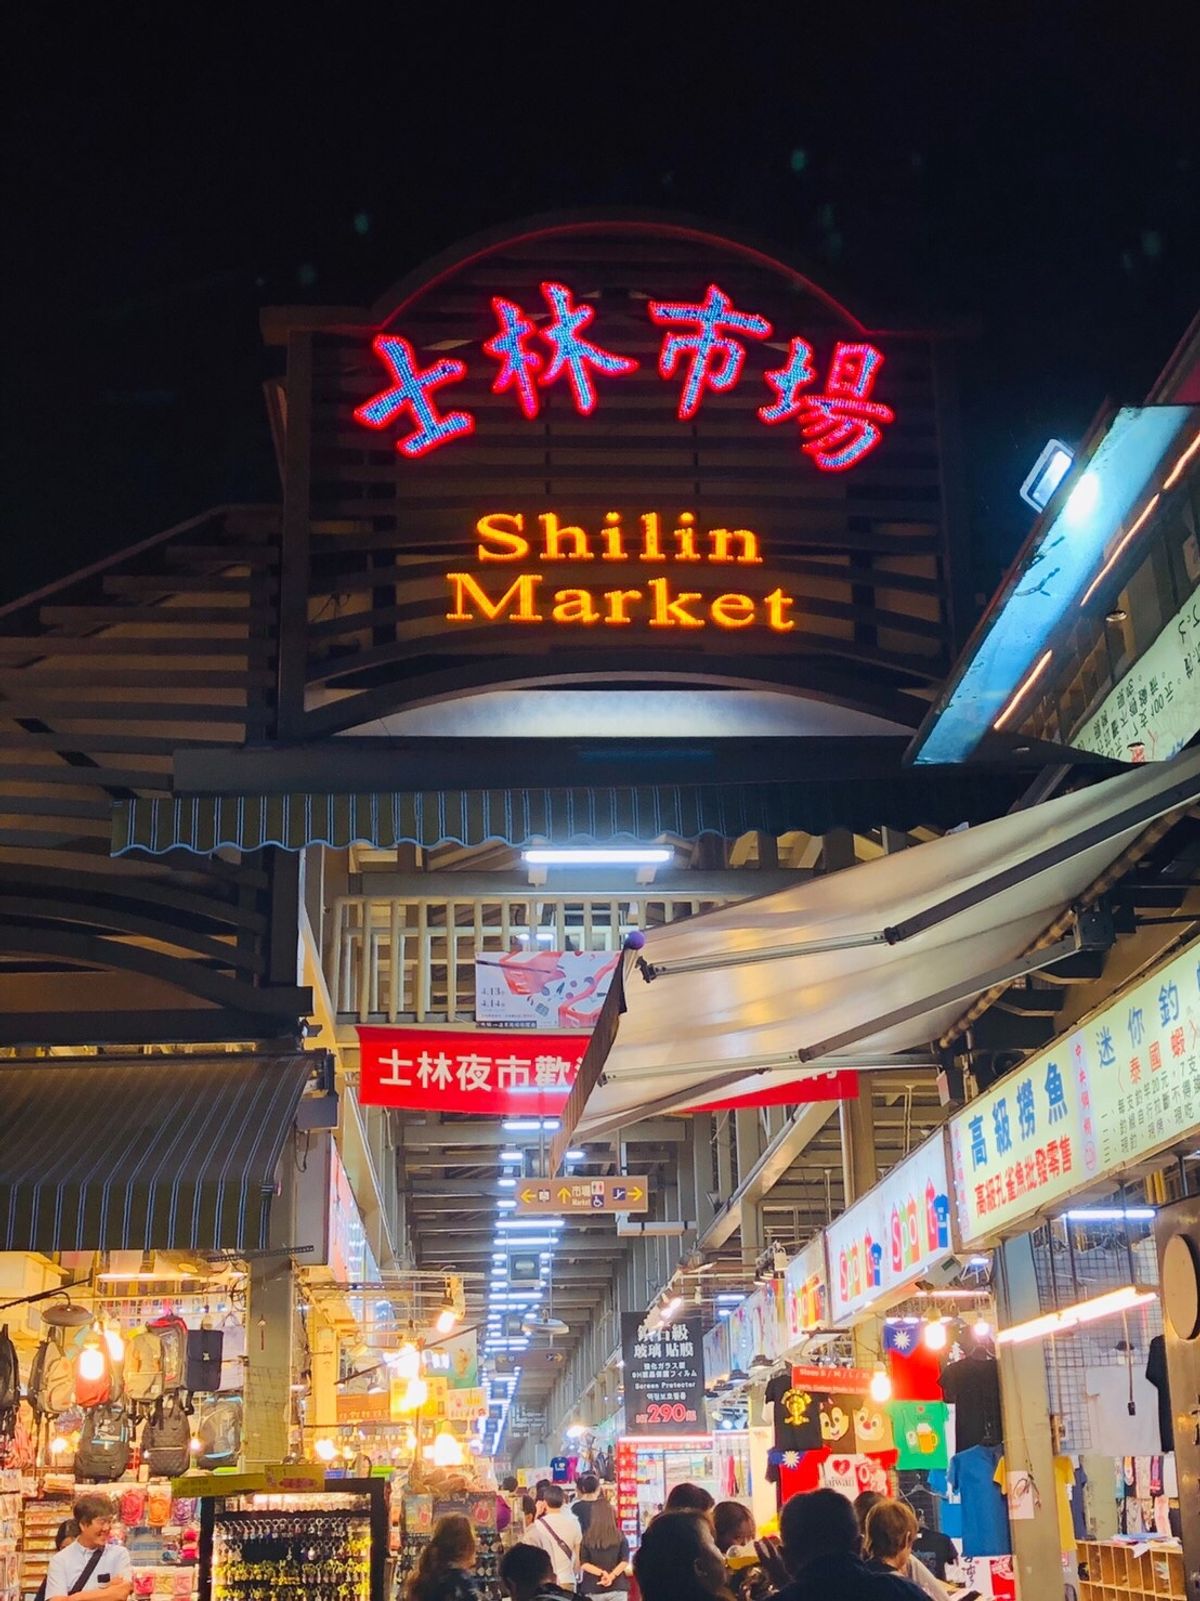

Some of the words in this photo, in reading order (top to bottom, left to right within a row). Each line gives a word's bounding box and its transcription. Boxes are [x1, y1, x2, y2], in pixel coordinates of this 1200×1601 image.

[353, 281, 895, 472] 士林市場
[476, 512, 763, 564] Shilin
[446, 572, 795, 632] Market
[1096, 960, 1200, 1067] 迷你釣
[378, 1048, 583, 1092] 士林夜市歡
[968, 1062, 1068, 1172] 高級撈魚
